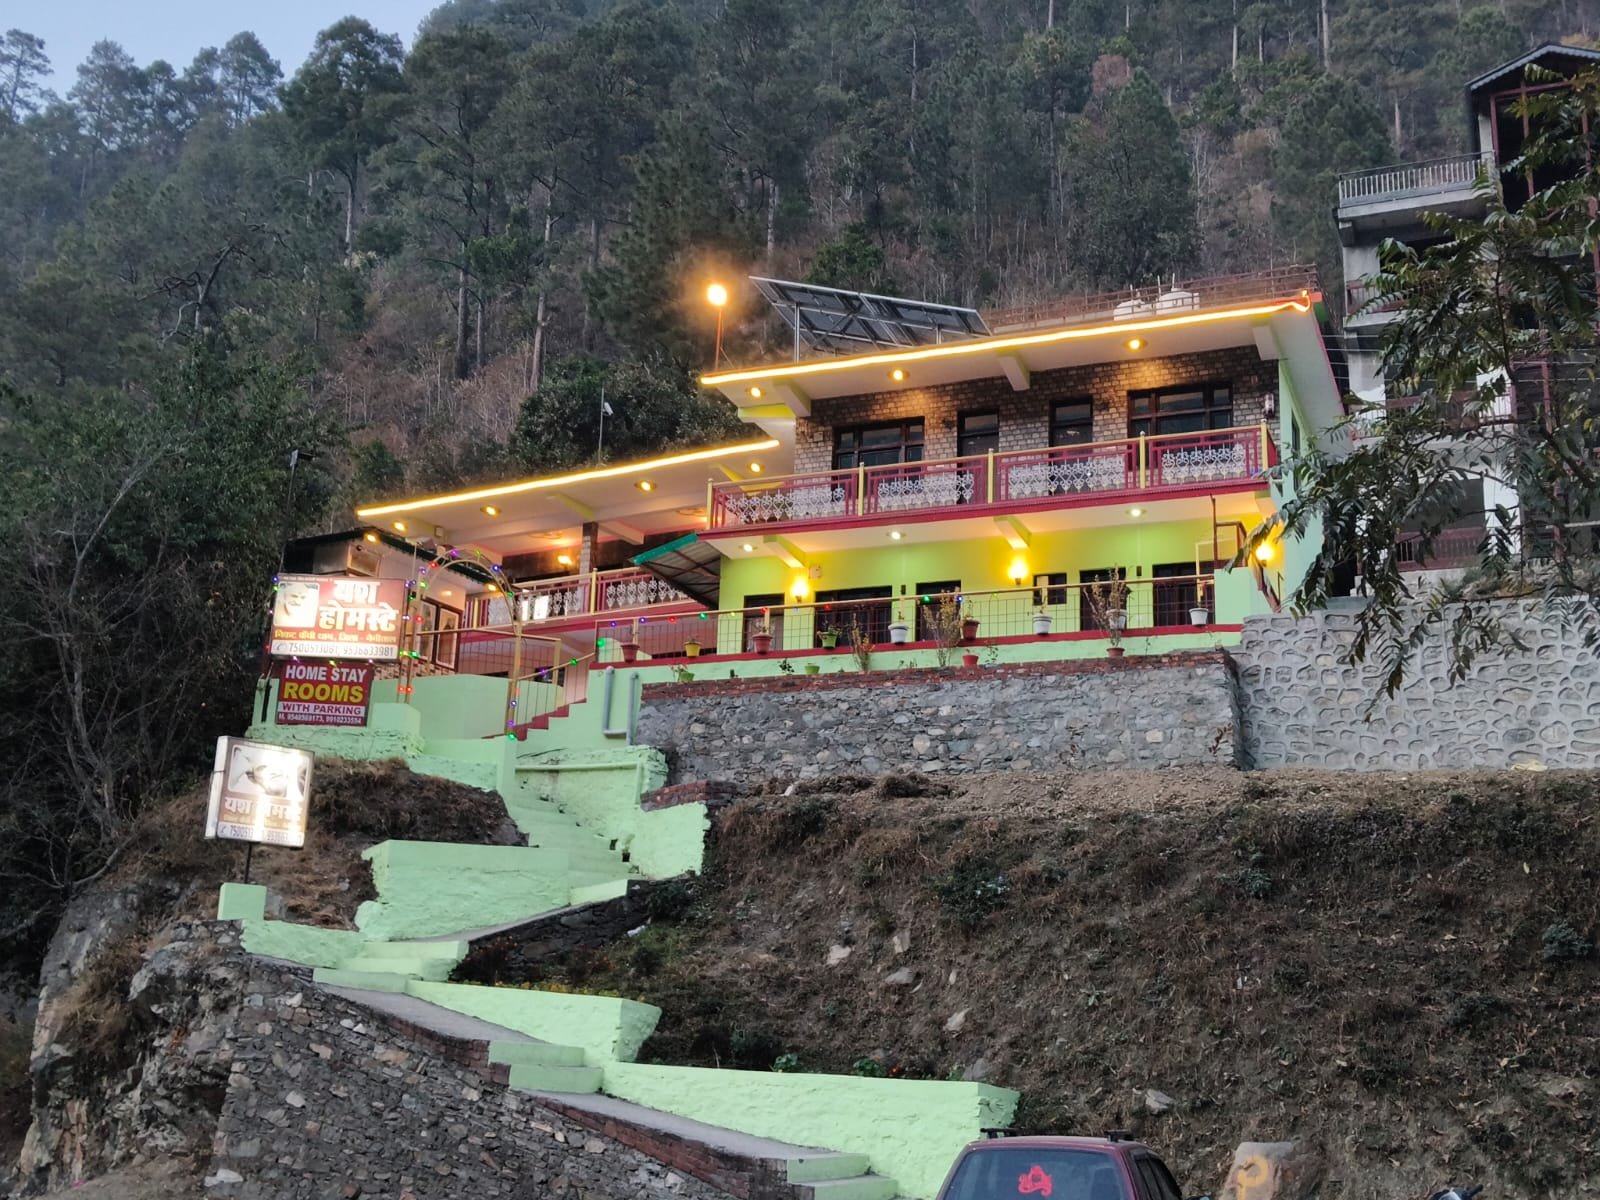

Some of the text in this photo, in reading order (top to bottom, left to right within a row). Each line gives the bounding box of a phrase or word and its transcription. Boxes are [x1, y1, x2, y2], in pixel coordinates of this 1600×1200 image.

[319, 600, 399, 632] होमस्टे
[286, 665, 367, 683] HOME STAY
[283, 681, 364, 703] ROOMS
[282, 703, 361, 715] WITH PARKING
